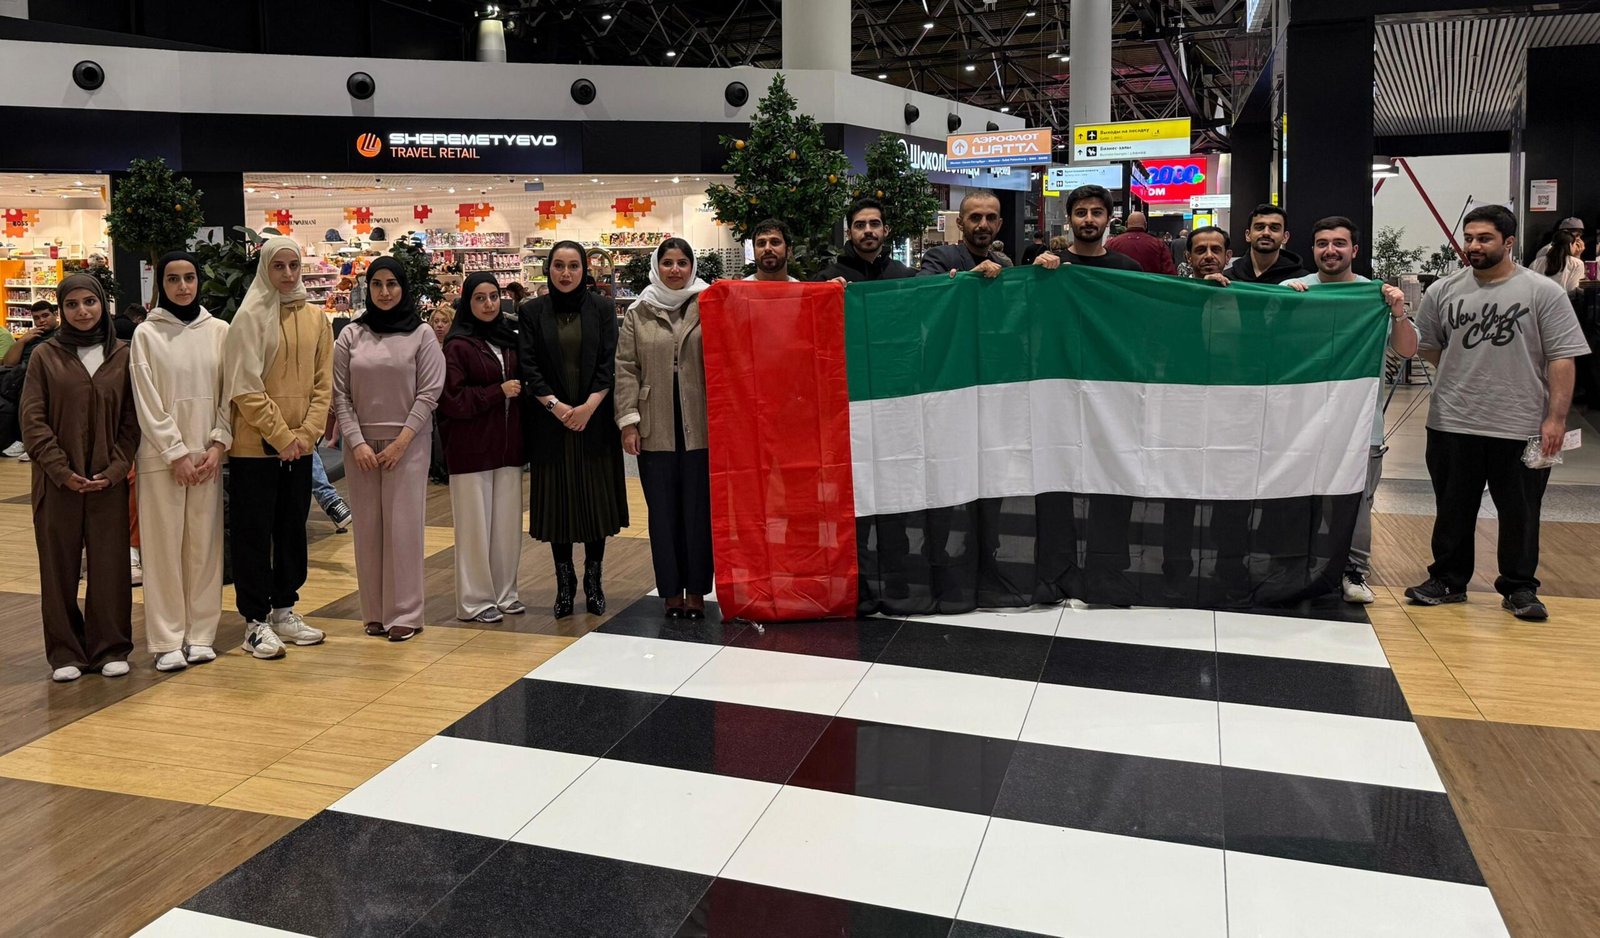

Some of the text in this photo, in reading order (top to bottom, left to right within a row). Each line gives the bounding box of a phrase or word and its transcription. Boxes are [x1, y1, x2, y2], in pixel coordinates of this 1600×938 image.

[388, 133, 558, 146] SHEREMETYEVO
[972, 133, 1040, 144] АЭРОФЛОТ
[390, 147, 481, 159] TRAVEL RETAIL
[971, 142, 1039, 155] ШАТТЛ
[1448, 299, 1476, 329] New
